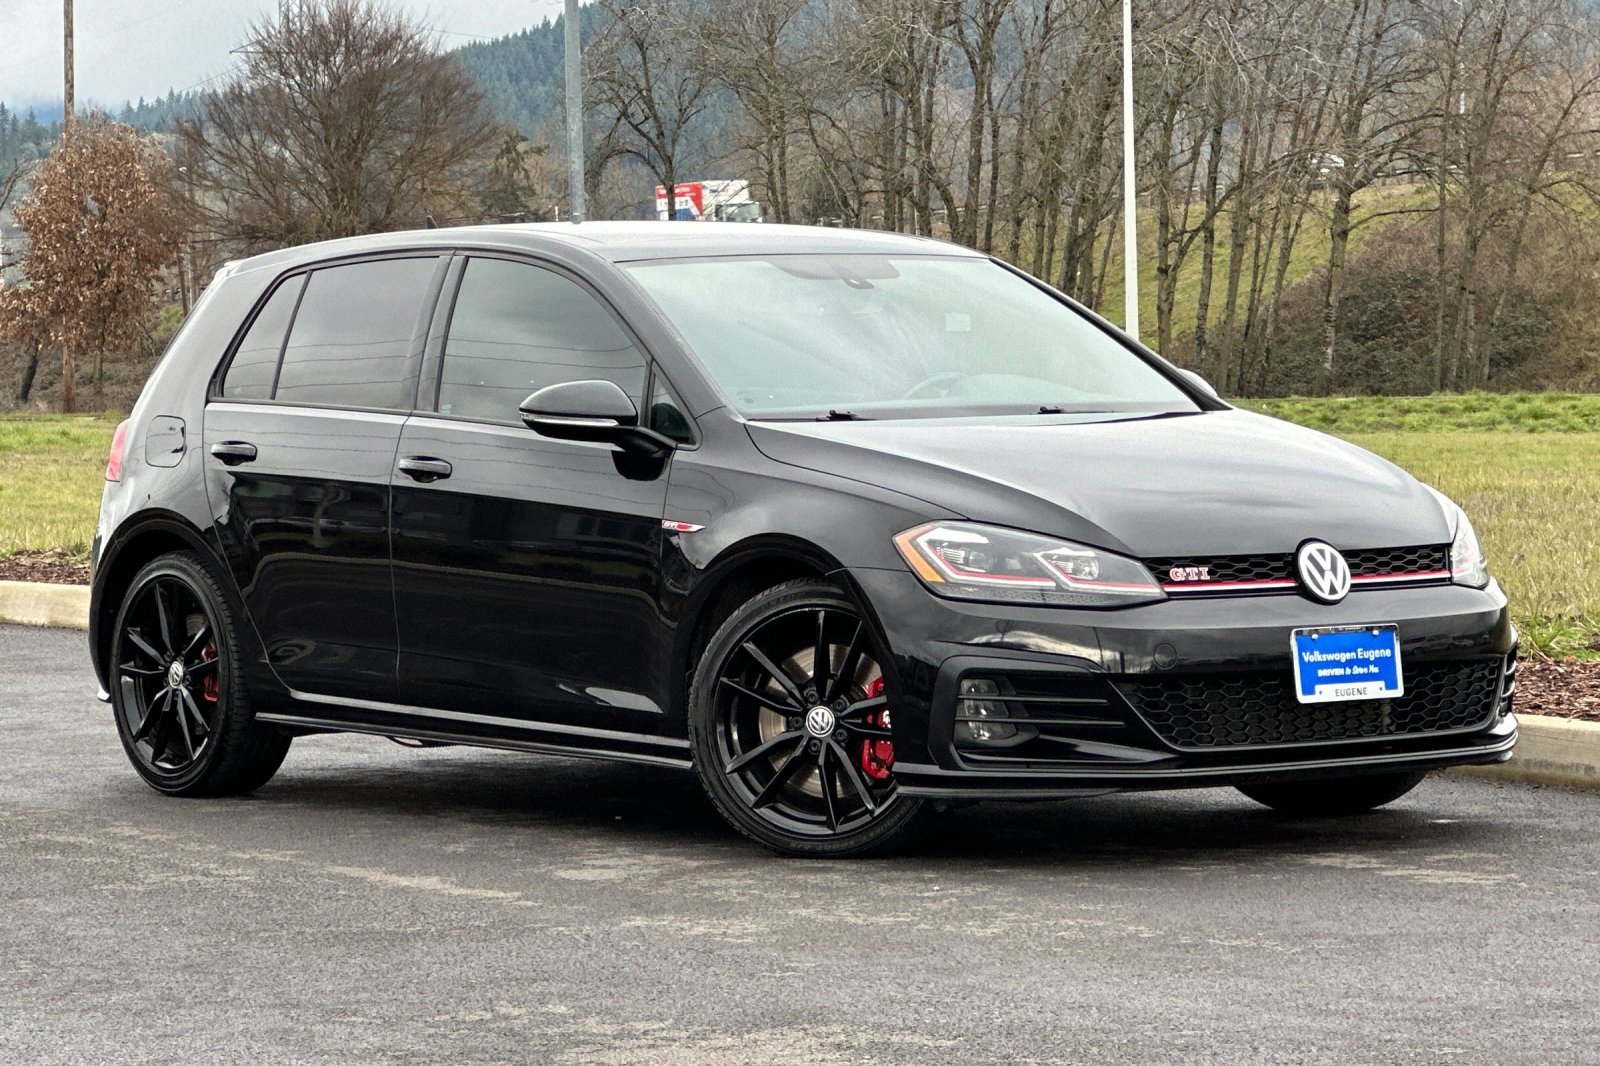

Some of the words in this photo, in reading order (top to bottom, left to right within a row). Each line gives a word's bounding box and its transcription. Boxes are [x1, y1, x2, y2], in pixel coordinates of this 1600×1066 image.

[1169, 567, 1210, 582] GTI
[1299, 542, 1351, 600] VW
[1302, 650, 1356, 663] Volkswagen
[1357, 648, 1391, 661] Eugene
[1318, 667, 1344, 677] DRIVEN
[1335, 687, 1368, 697] EUGENE
